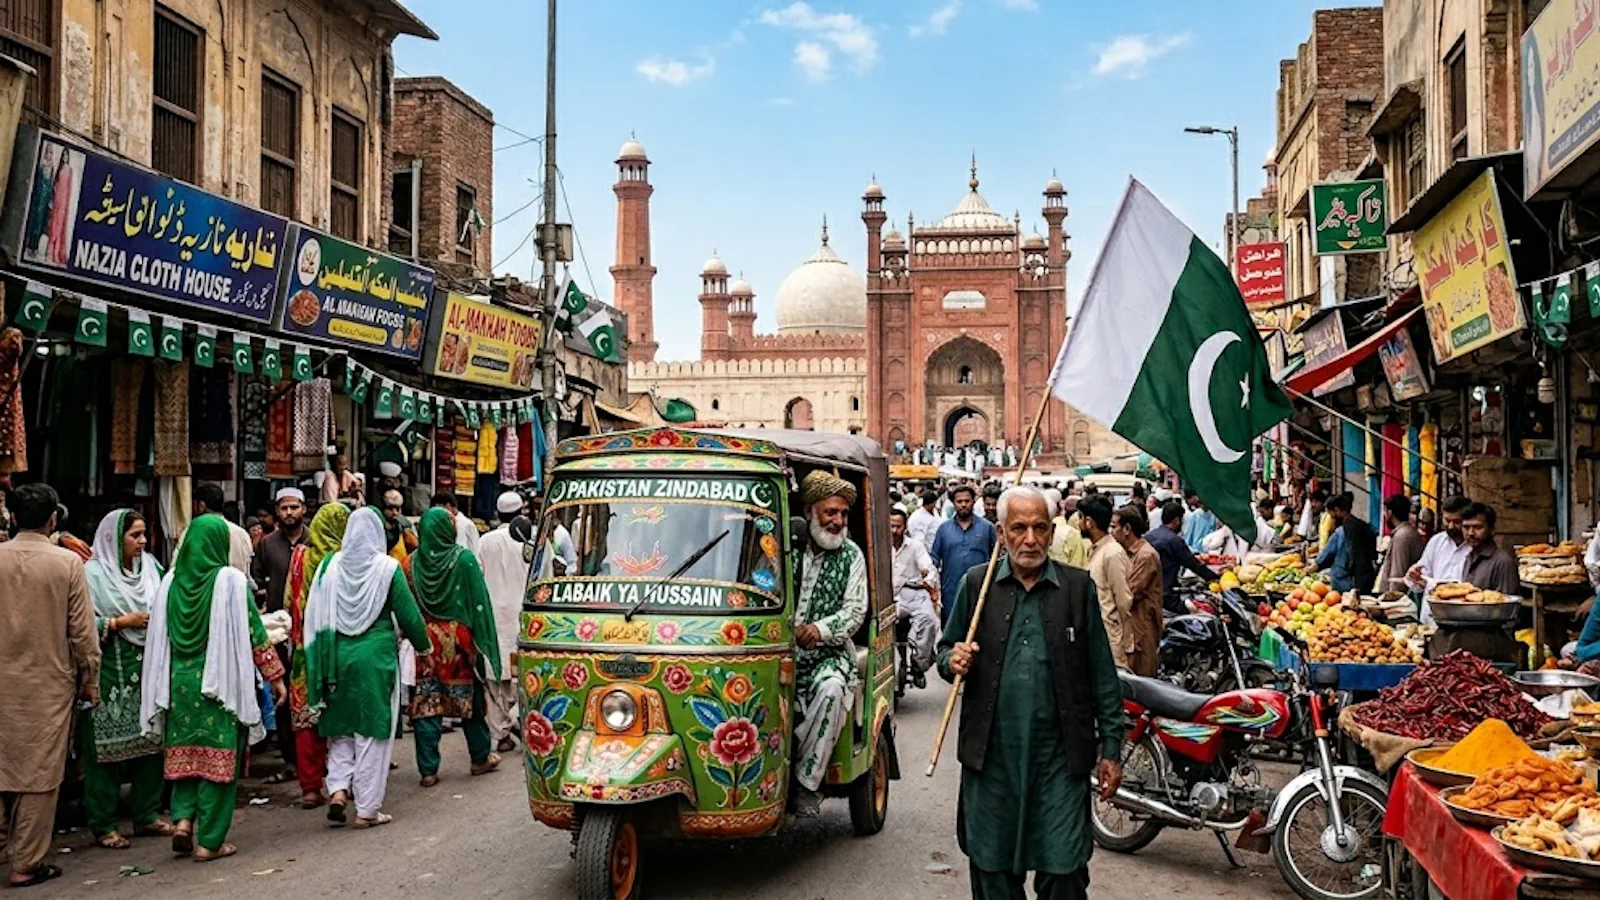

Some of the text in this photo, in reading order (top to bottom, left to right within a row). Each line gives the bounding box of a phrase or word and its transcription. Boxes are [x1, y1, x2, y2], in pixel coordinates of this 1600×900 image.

[74, 238, 127, 280] NAZIA
[129, 253, 183, 293] CLOTH
[183, 266, 233, 304] HOUSE
[321, 294, 336, 313] AL
[566, 479, 748, 501] PAKISTAN ZINDABAD
[551, 582, 723, 607] LABAIK YA HUSSAIN
